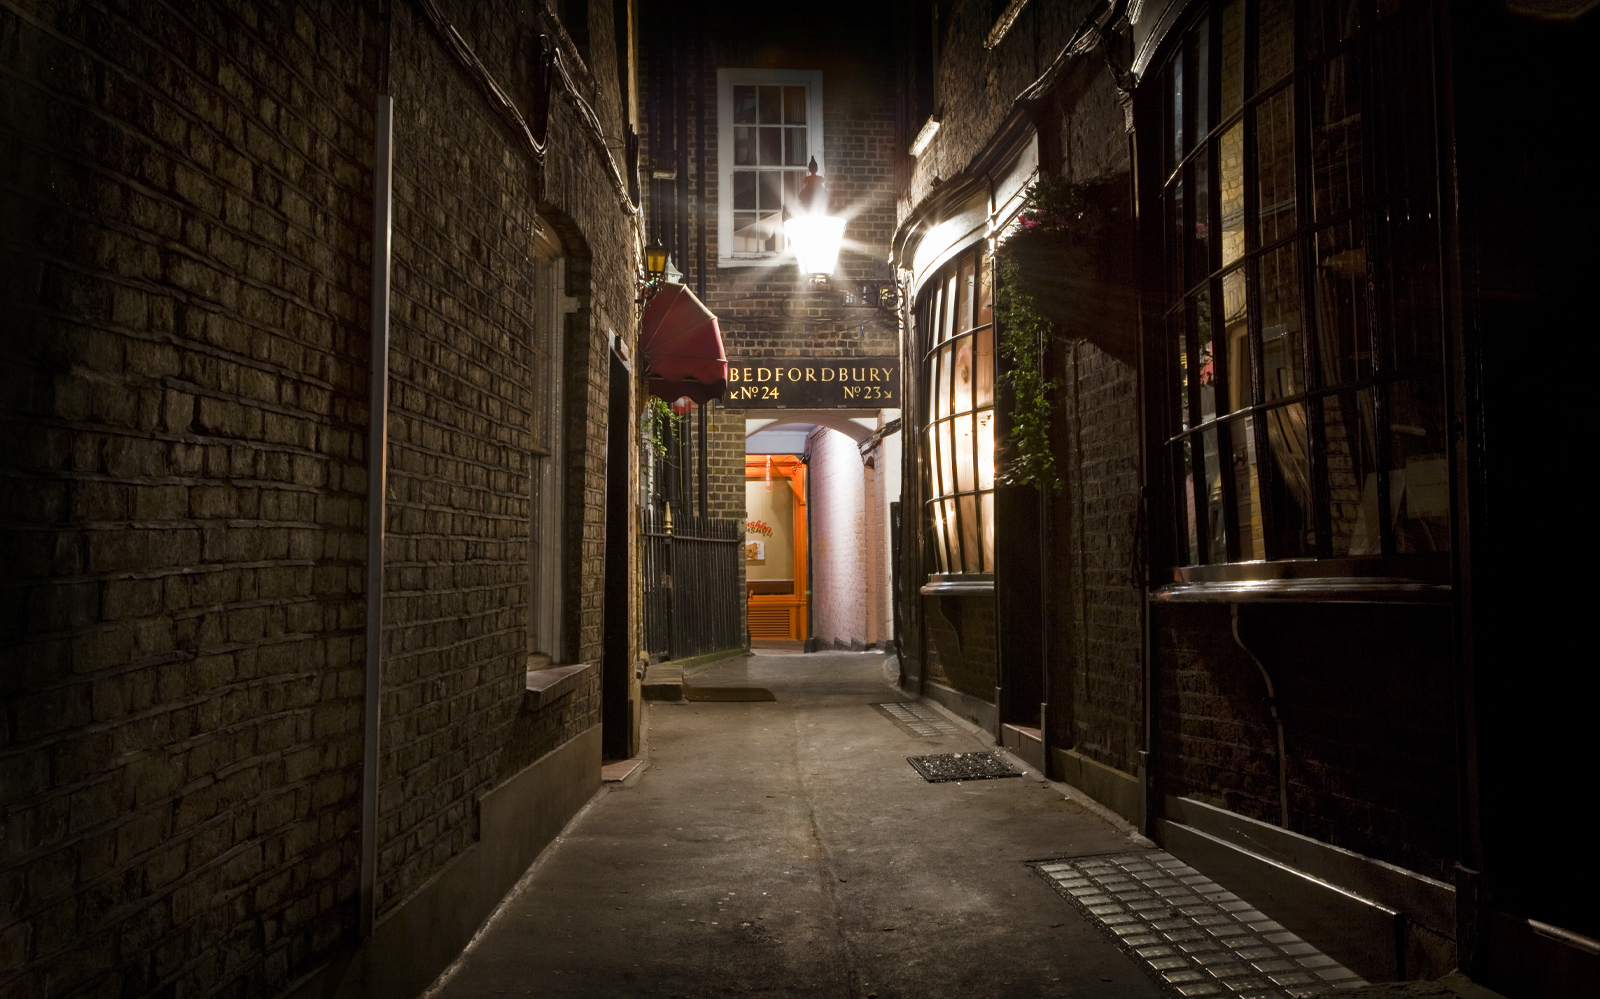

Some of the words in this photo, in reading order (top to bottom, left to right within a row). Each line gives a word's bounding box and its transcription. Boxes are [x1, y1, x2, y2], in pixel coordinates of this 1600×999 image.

[729, 367, 894, 382] BEDFORDBURY
[761, 386, 780, 400] 24
[864, 386, 882, 400] 23
